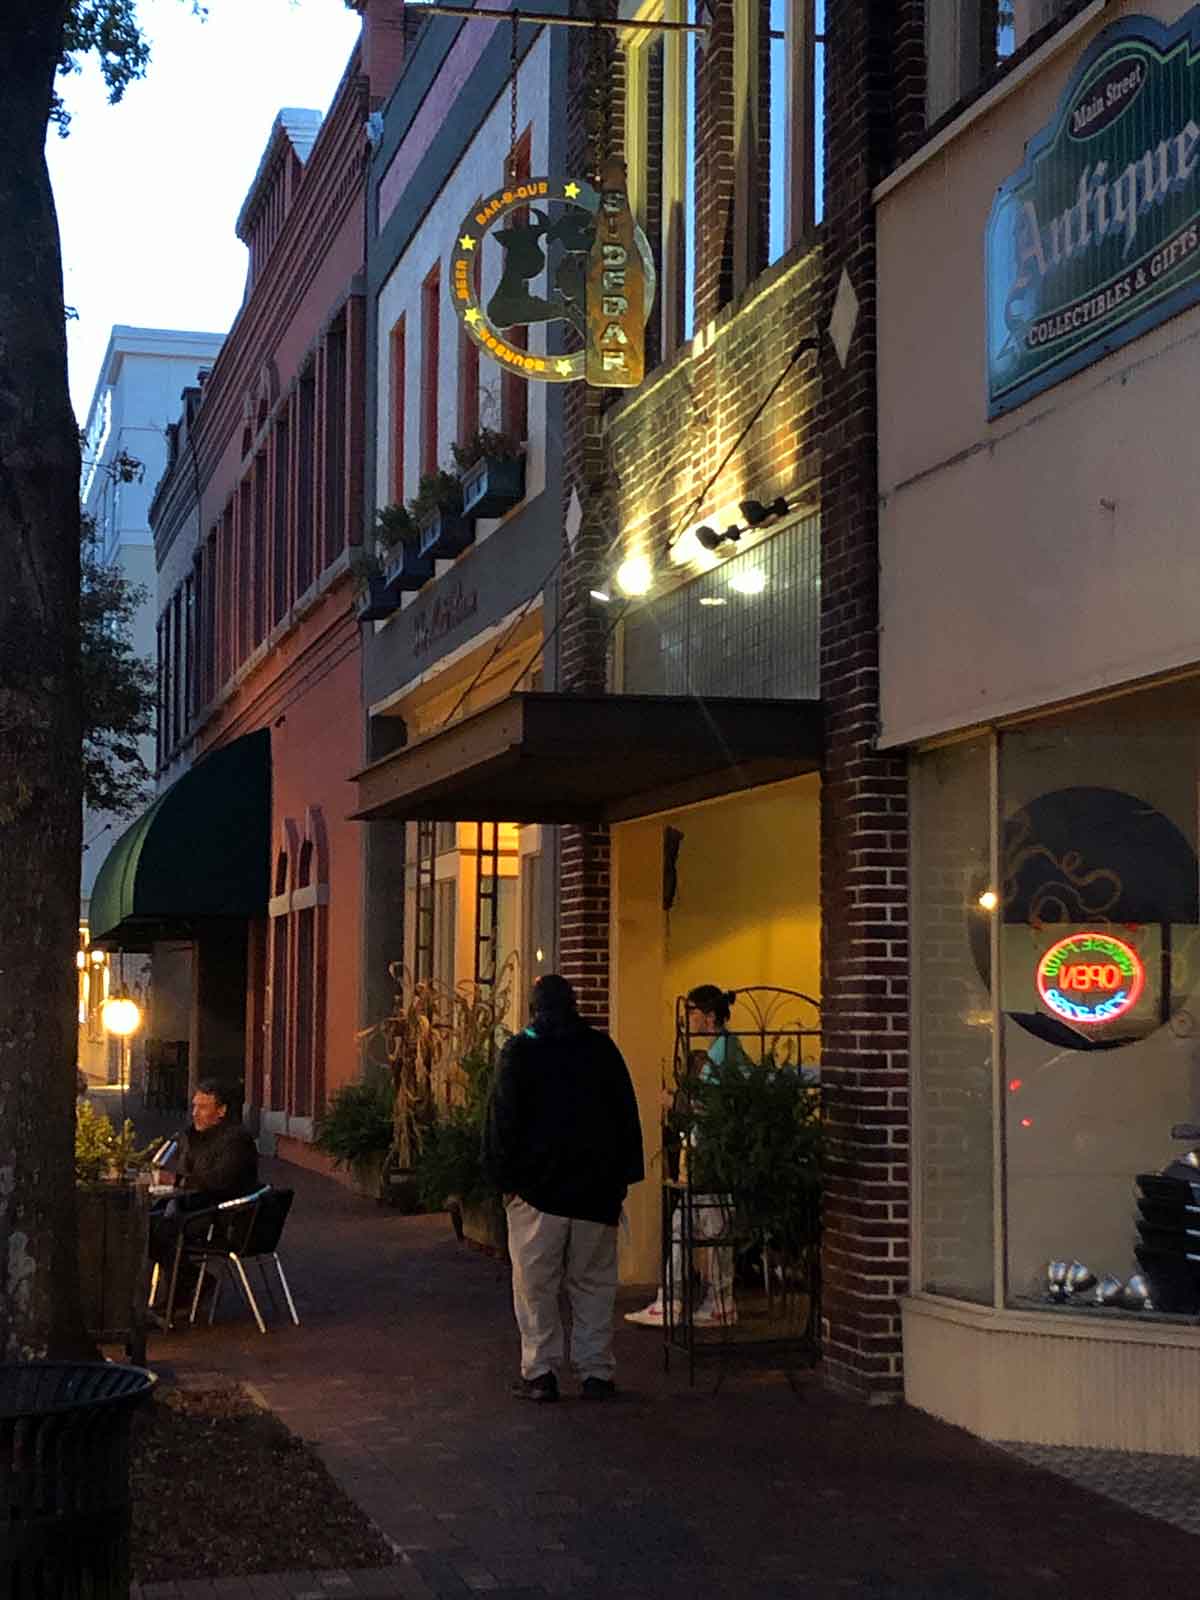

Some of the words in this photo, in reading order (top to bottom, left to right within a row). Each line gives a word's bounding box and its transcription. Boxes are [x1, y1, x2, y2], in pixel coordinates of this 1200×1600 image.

[1073, 96, 1104, 132] Main
[1105, 64, 1141, 107] Street
[456, 260, 470, 299] BEER
[1029, 276, 1131, 345] COLLECTIBLES
[1136, 267, 1148, 289] &
[1150, 225, 1198, 278] GIFTS
[479, 329, 545, 371] BOURBON
